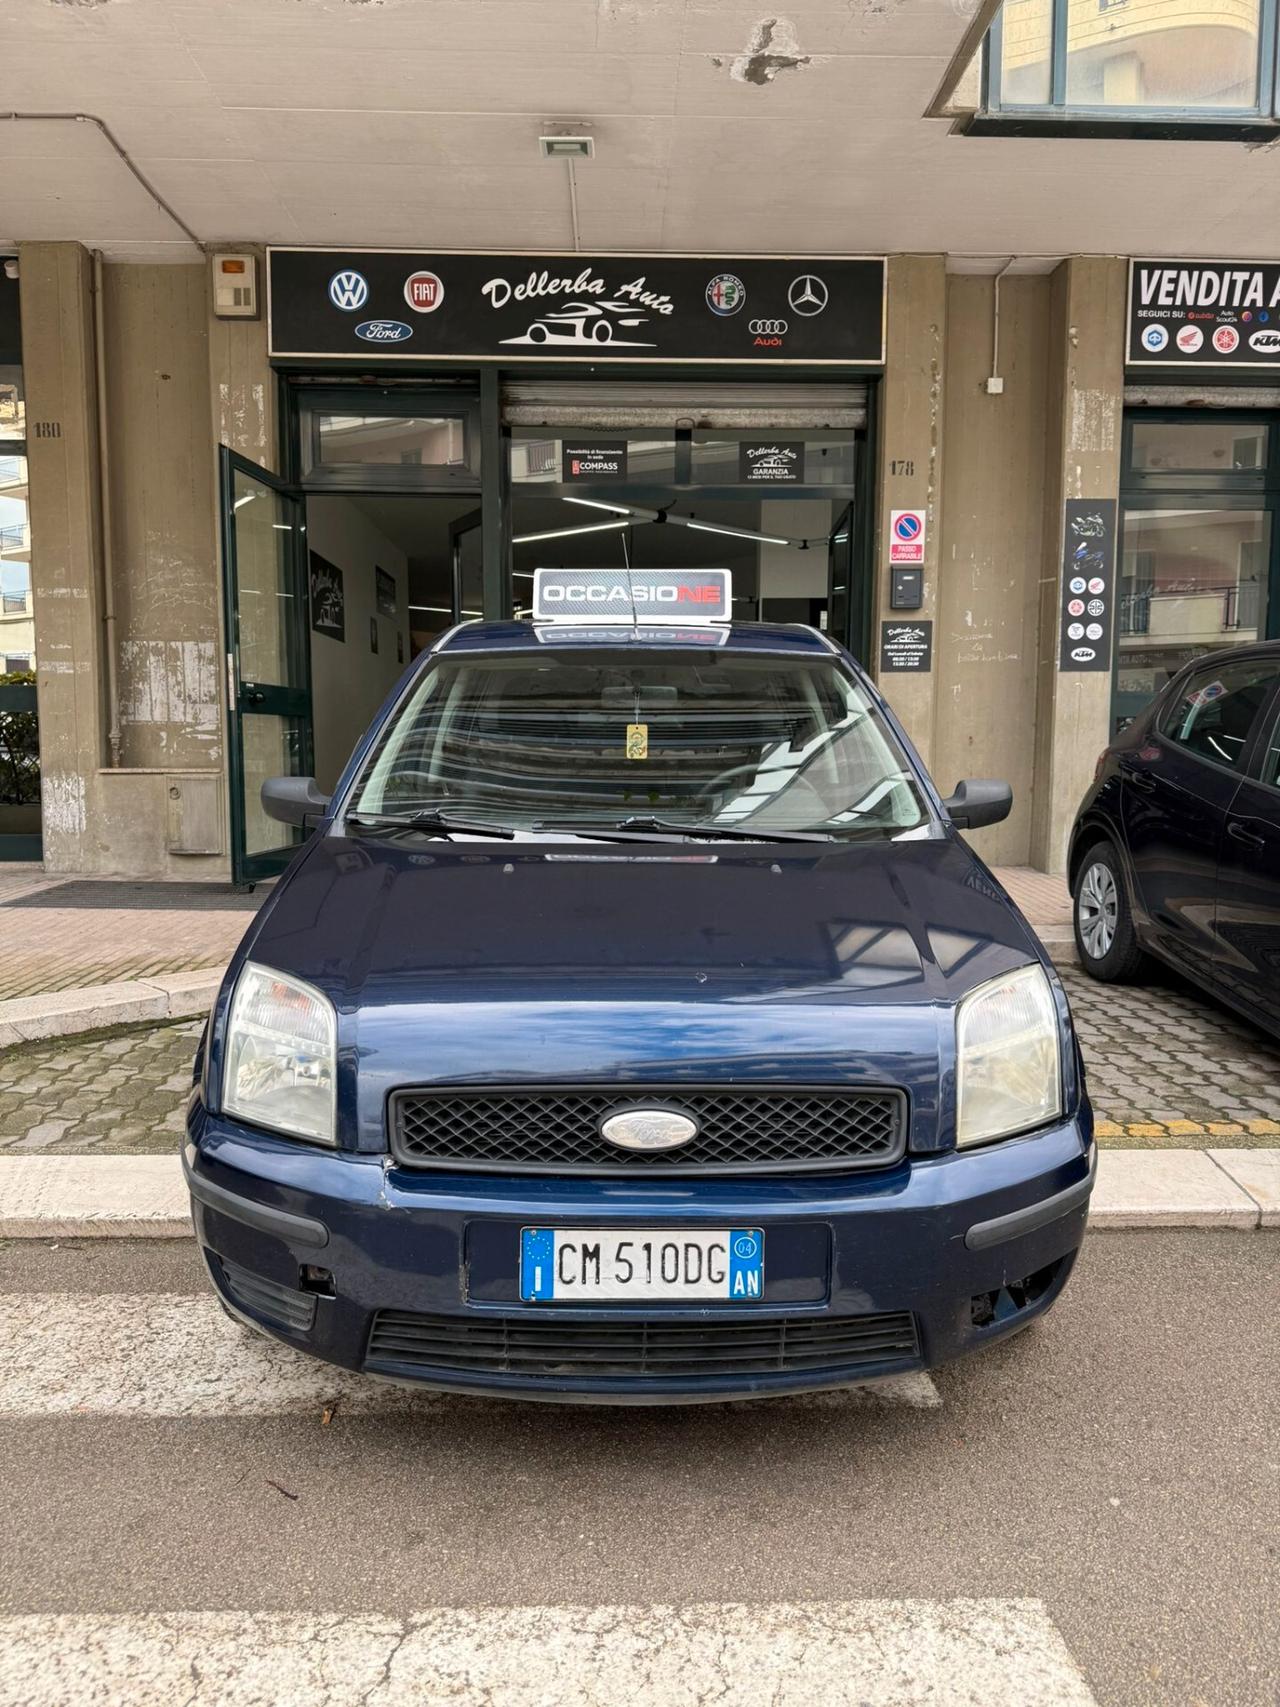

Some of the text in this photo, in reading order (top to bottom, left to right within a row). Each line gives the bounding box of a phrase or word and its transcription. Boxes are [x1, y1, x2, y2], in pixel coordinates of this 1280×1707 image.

[413, 283, 435, 301] FIAT
[481, 267, 674, 315] Dellerba Auto
[1140, 269, 1264, 307] VENDITA
[1137, 310, 1170, 319] SEGUICI
[1172, 311, 1186, 319] SU:
[365, 322, 402, 339] Ford
[753, 336, 782, 346] Audi
[33, 422, 61, 438] 180
[580, 462, 618, 470] COMPASS
[889, 461, 914, 476] 178
[543, 585, 721, 603] OCCASIONE
[738, 1242, 753, 1254] 04
[558, 1242, 726, 1285] CM 510DG
[733, 1270, 759, 1296] AN
